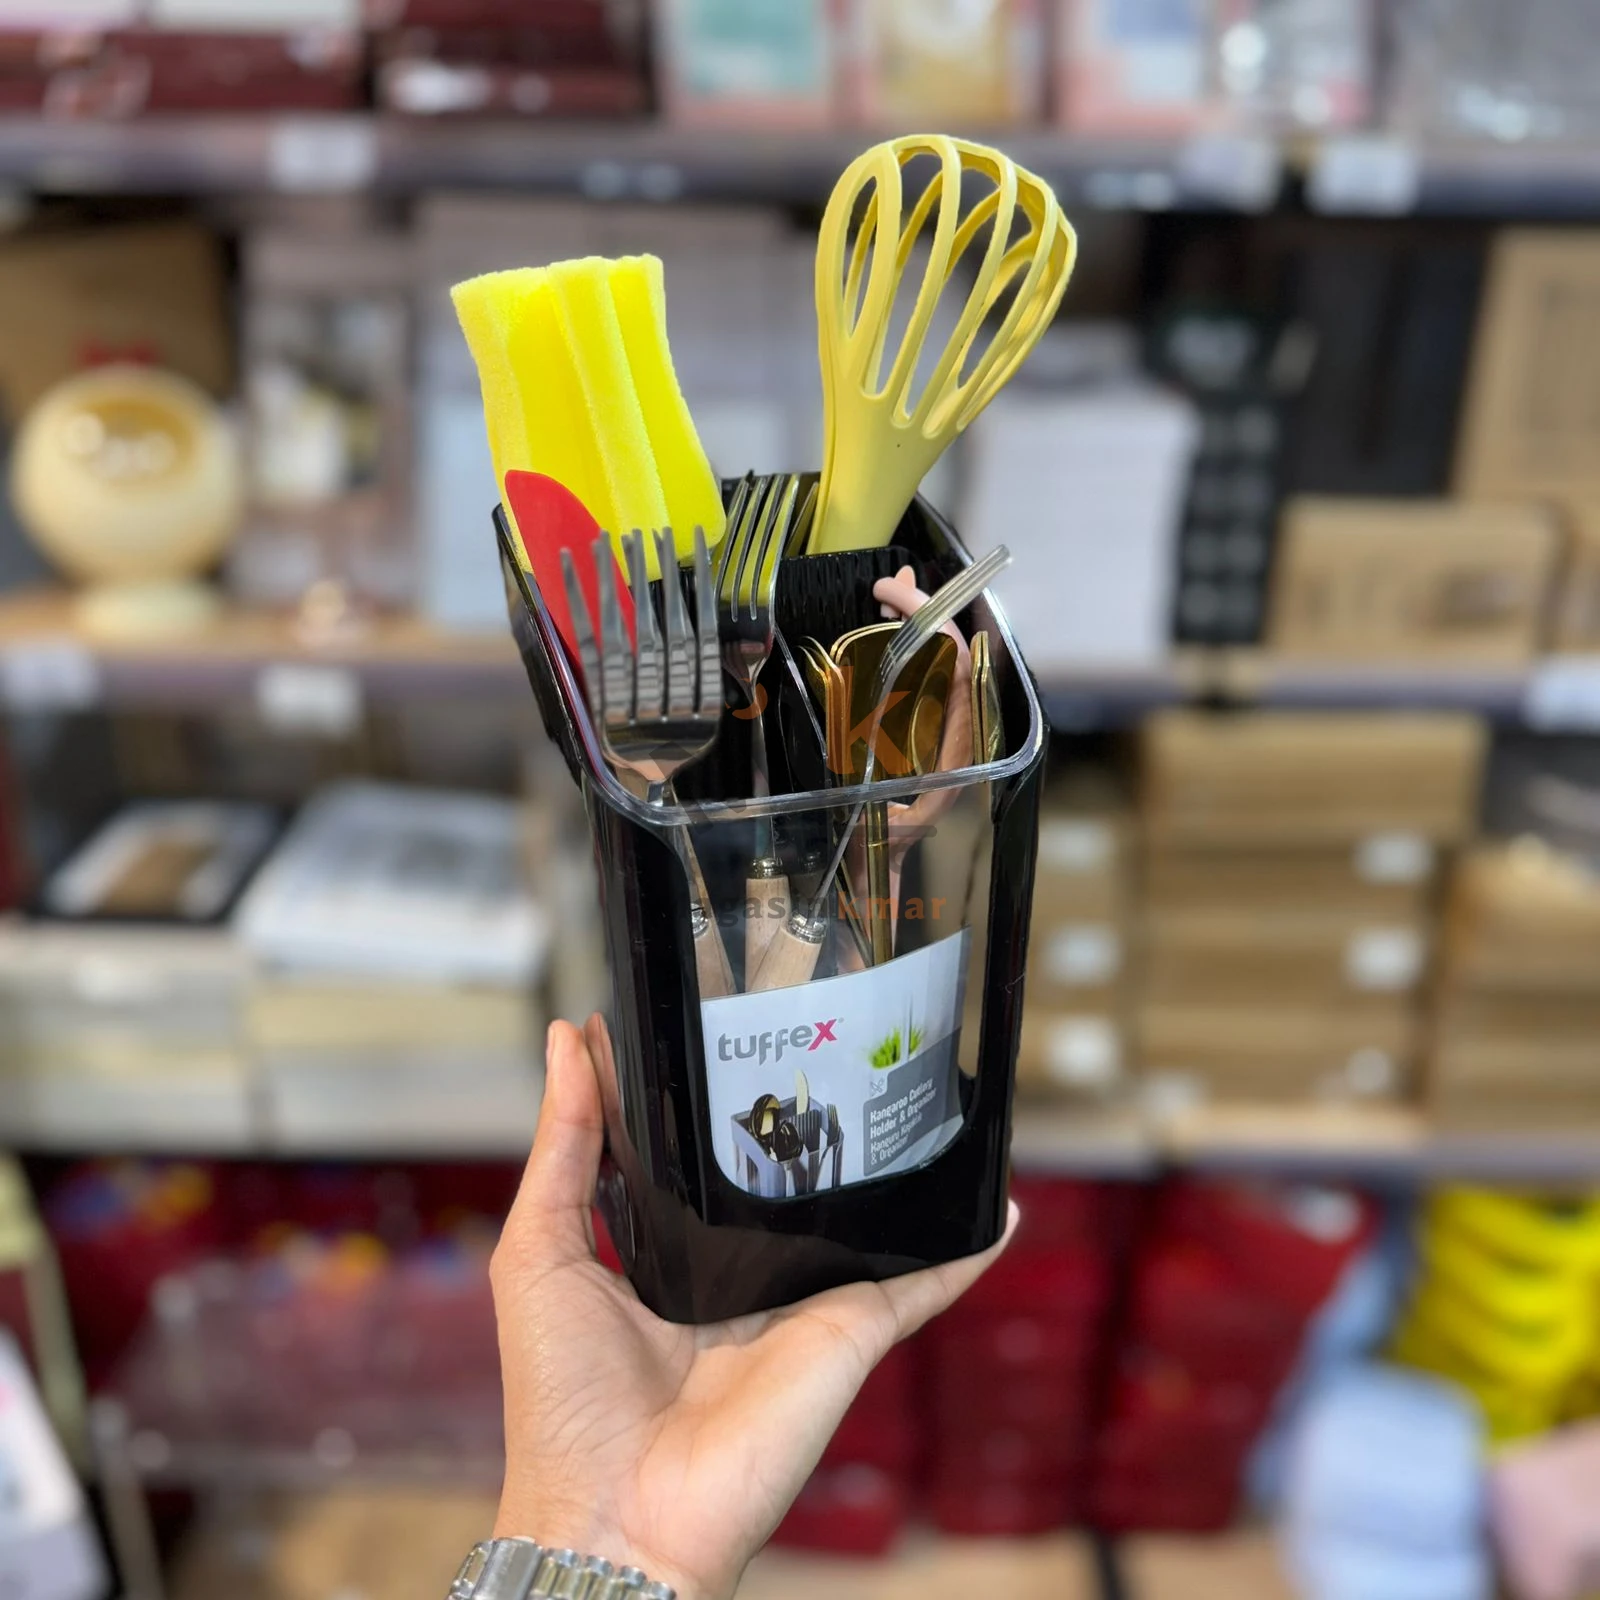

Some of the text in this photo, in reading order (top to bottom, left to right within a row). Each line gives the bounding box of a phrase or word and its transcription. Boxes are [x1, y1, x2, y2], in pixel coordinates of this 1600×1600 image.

[717, 1018, 838, 1066] tuffex
[870, 1096, 908, 1123] Kangaroo
[870, 1117, 897, 1139] Holder
[899, 1110, 906, 1123] &
[871, 1152, 877, 1165] &
